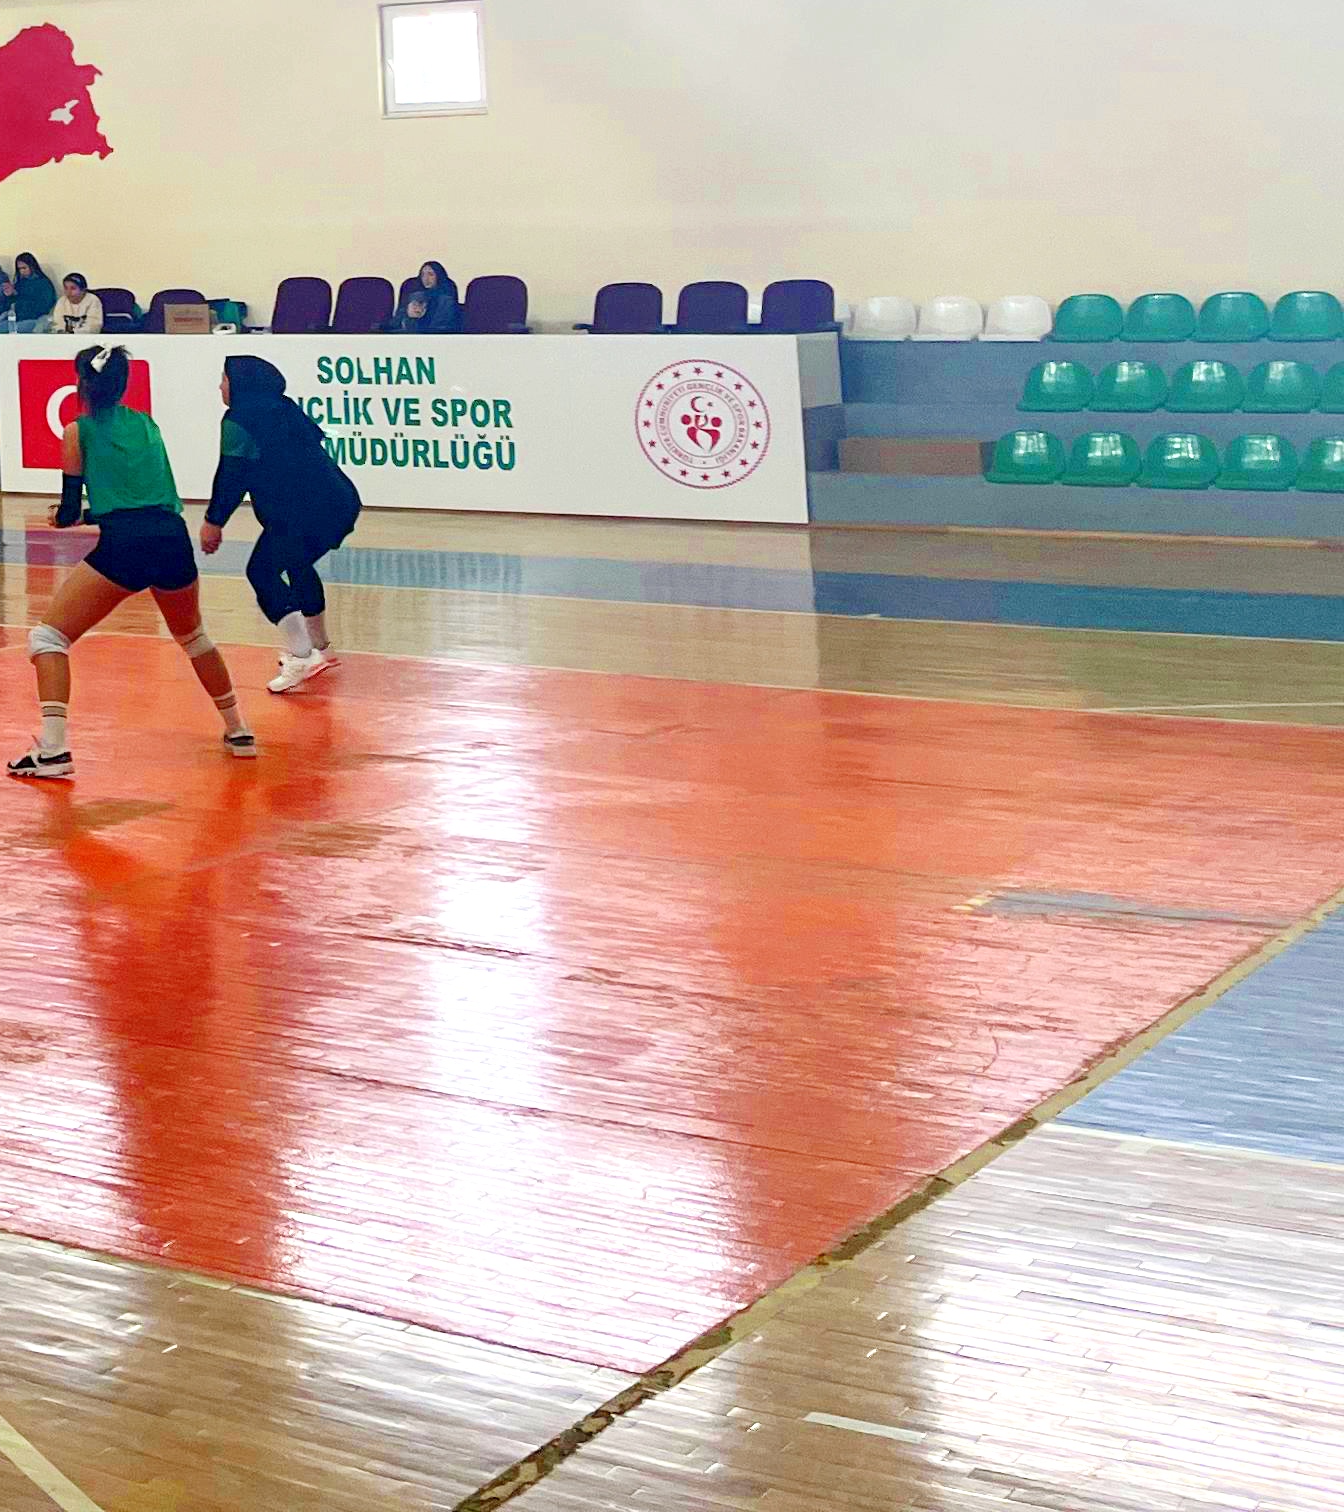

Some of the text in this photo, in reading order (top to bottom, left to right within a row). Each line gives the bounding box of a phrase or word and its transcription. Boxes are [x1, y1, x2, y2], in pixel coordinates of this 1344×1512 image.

[316, 355, 436, 386] SOLHAN
[382, 397, 421, 427] VE
[430, 398, 514, 429] SPOR
